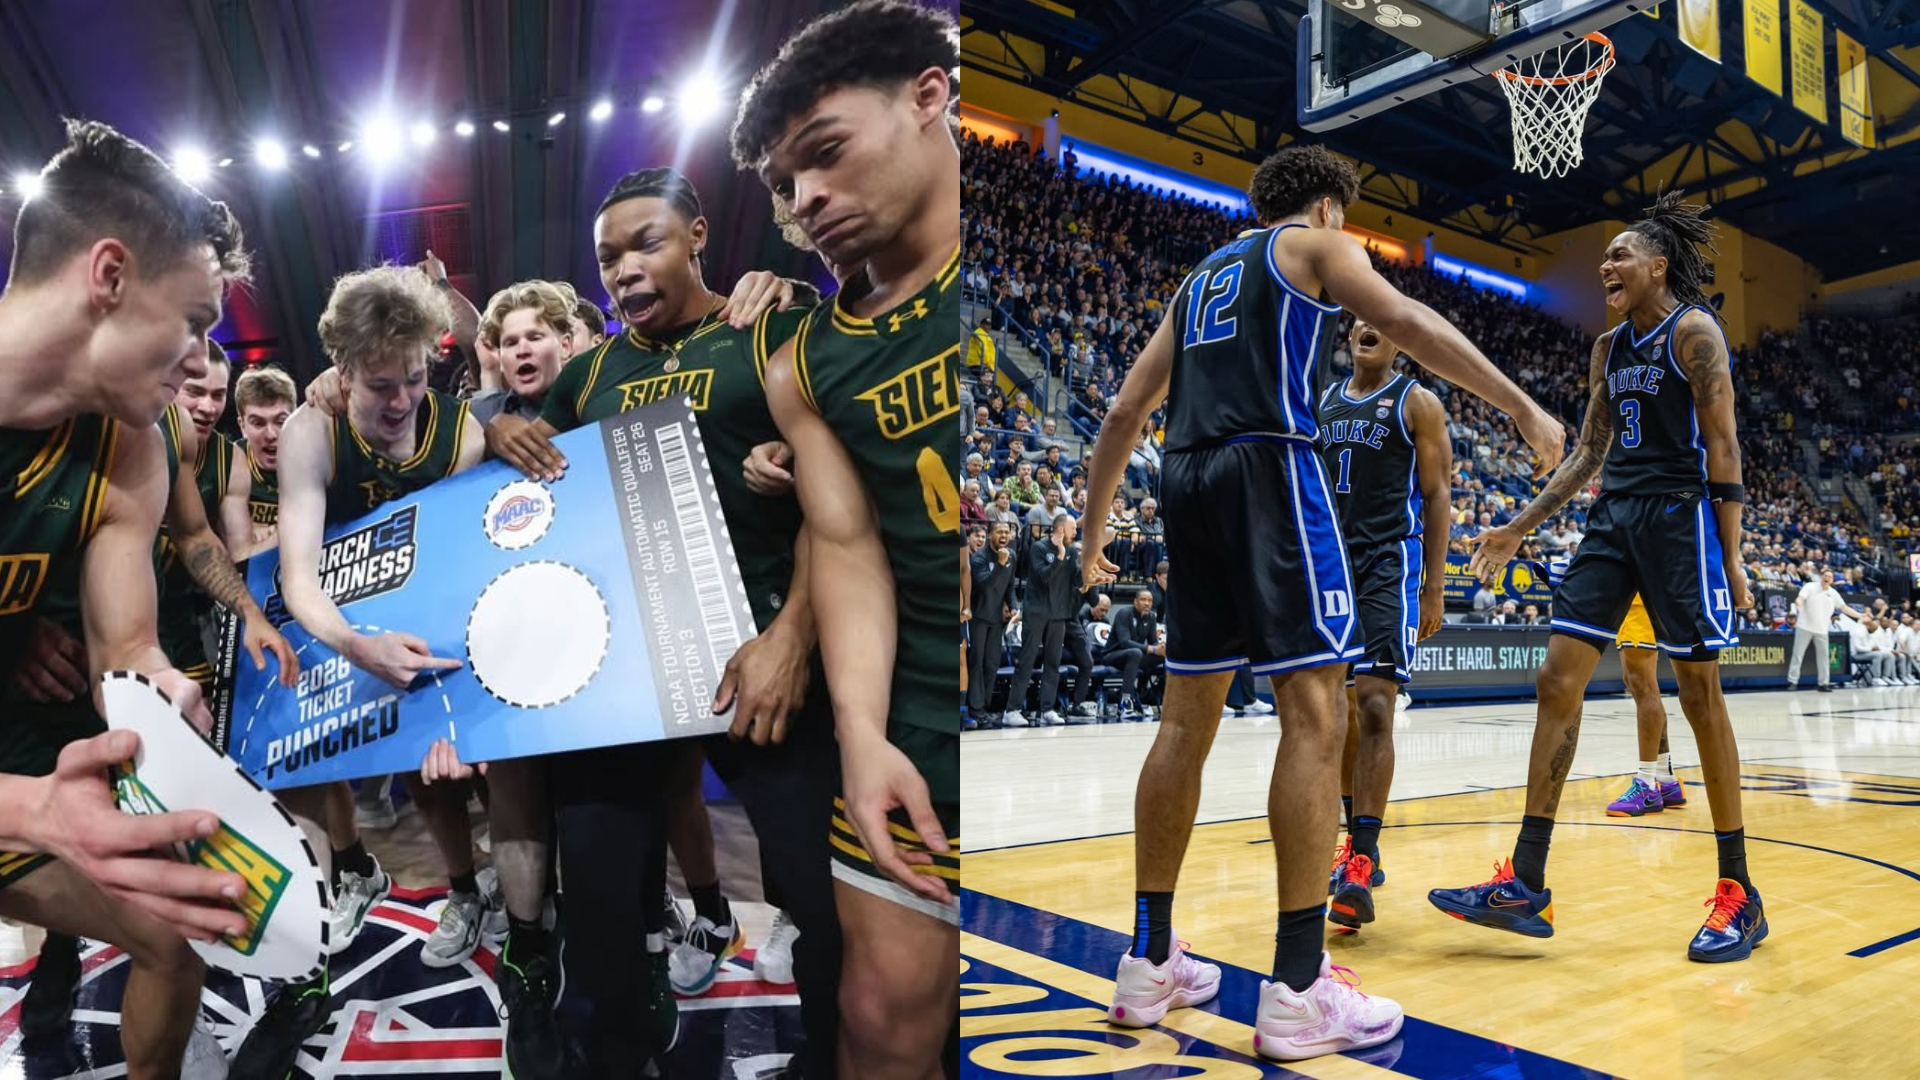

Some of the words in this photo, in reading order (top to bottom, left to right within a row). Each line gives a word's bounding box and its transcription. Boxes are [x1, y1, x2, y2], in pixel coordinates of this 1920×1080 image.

[1192, 151, 1204, 166] 3
[1383, 214, 1393, 227] 4
[1183, 259, 1245, 351] 12
[618, 368, 715, 414] SIENA
[1608, 364, 1666, 400] DUKE
[630, 421, 646, 440] 26
[1619, 398, 1642, 449] 3
[612, 426, 639, 492] QUALIFIER
[634, 441, 653, 473] SEAT
[1335, 448, 1353, 494] 1
[916, 446, 960, 534] 4
[493, 497, 545, 537] MAAC
[627, 492, 655, 571] AUTOMATIC
[653, 519, 670, 538] 15
[318, 528, 373, 575] ARCH
[318, 544, 416, 599] ADNESS
[657, 538, 678, 575] ROW
[1444, 562, 1461, 575] Nor
[1322, 589, 1350, 617] D
[644, 574, 681, 678] TOURNAMENT
[679, 628, 694, 641] 3
[1413, 646, 1455, 671] USTLE
[1456, 646, 1497, 670] HARD.
[1499, 646, 1530, 670] STAY
[1718, 646, 1785, 665] USTLECLEAN.COM
[297, 656, 351, 698] 2026
[684, 645, 714, 719] SECTION
[298, 680, 355, 723] TICKET
[668, 679, 692, 725] NCAA
[266, 694, 399, 781] PUNCHED
